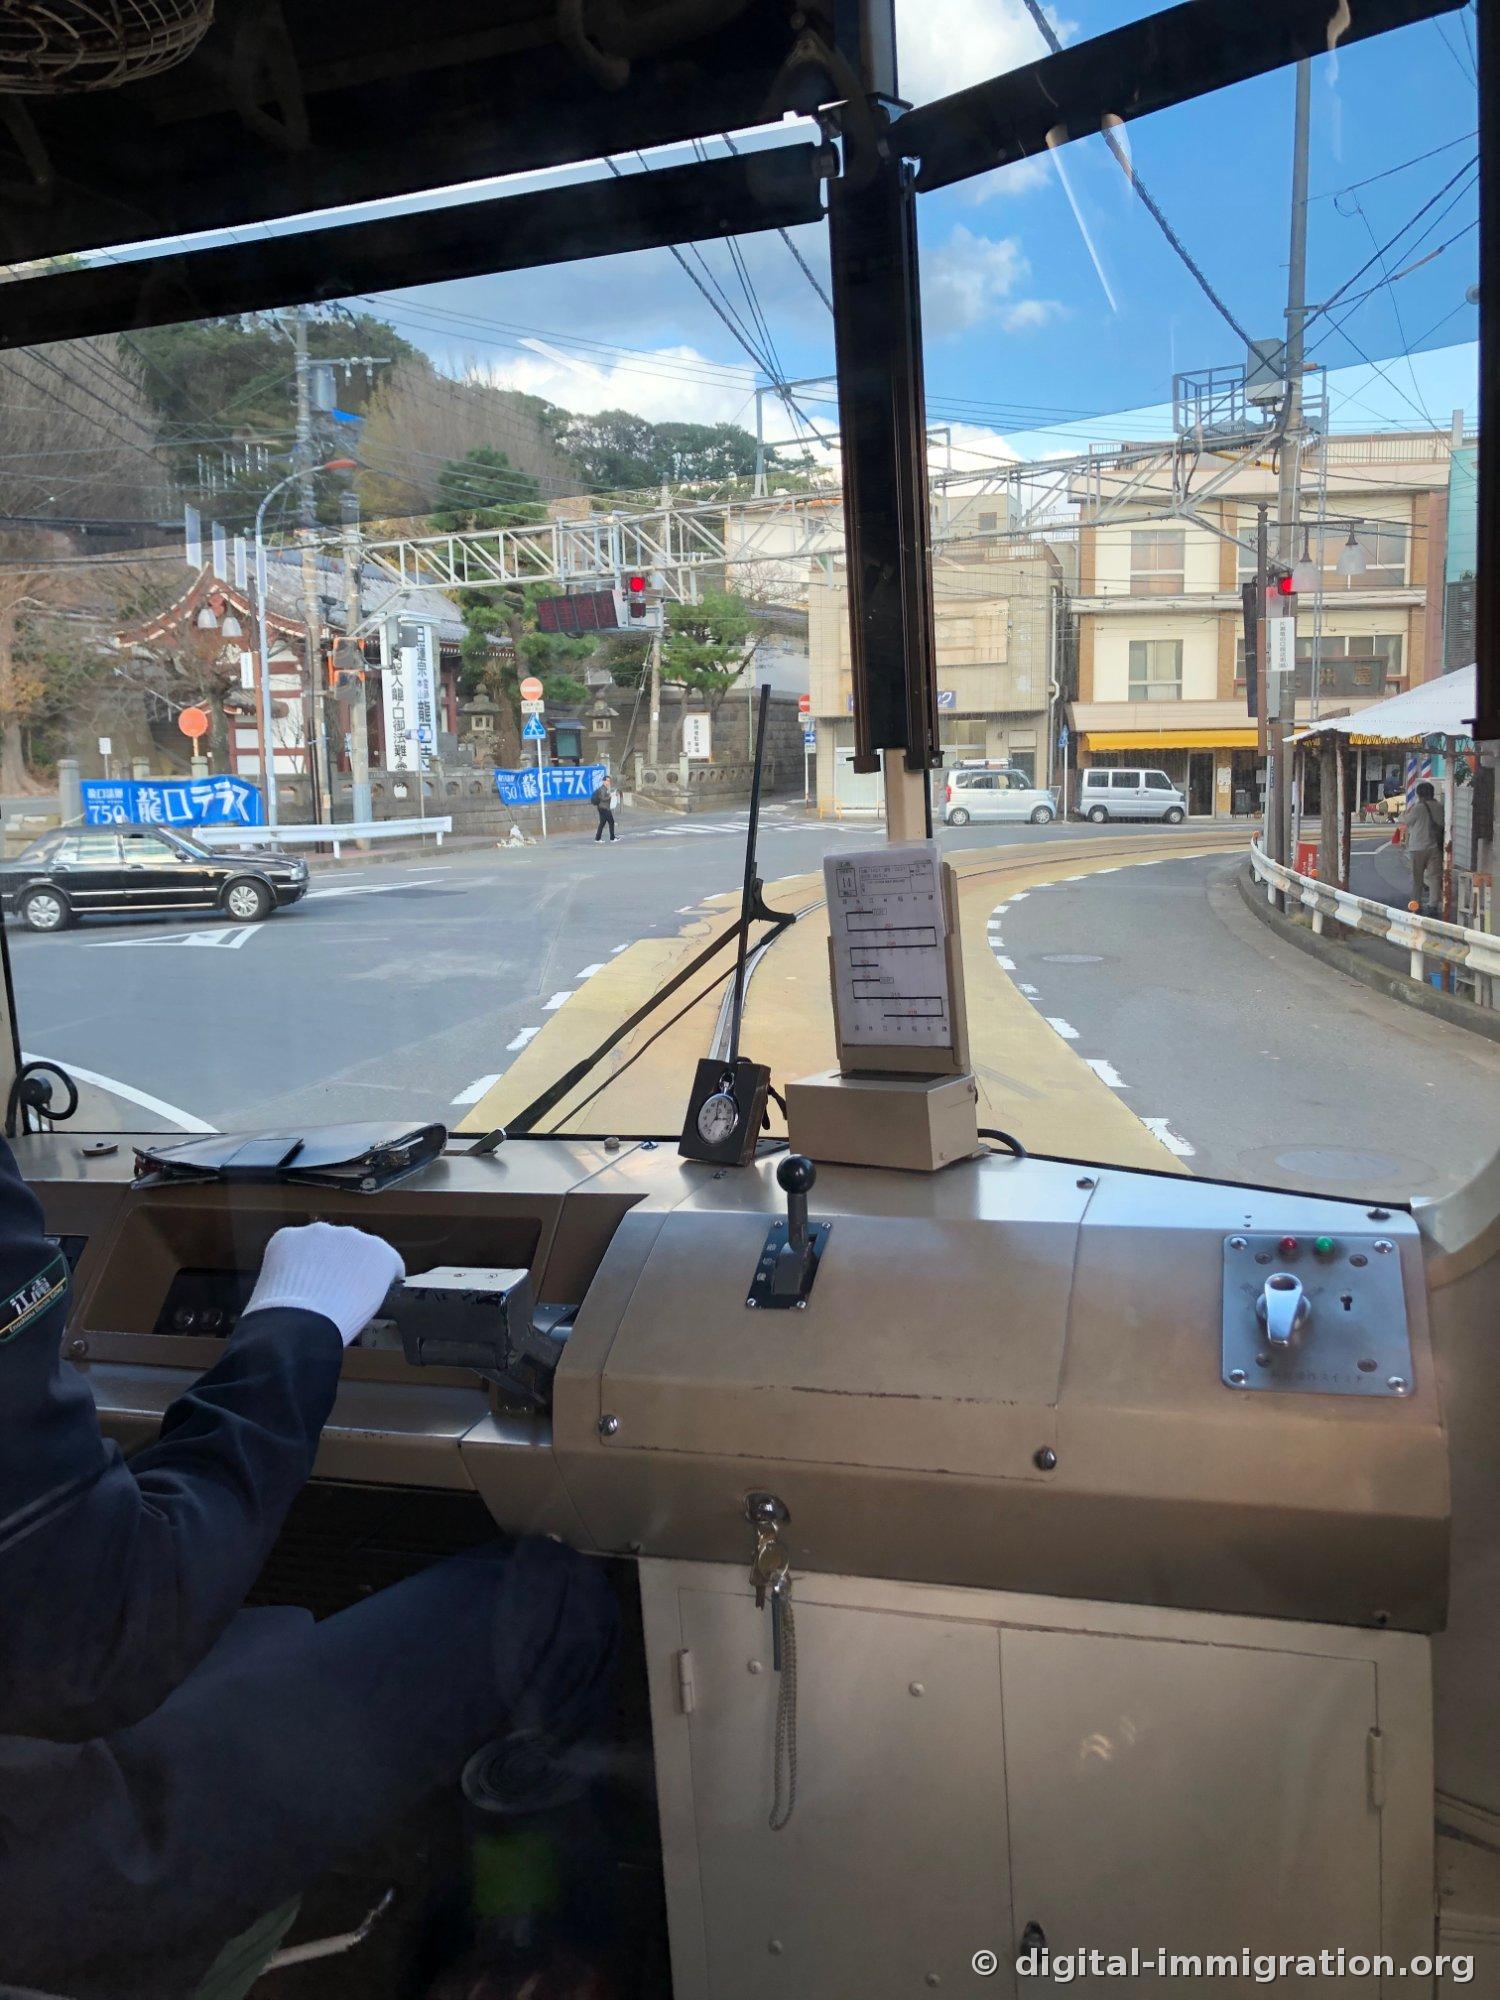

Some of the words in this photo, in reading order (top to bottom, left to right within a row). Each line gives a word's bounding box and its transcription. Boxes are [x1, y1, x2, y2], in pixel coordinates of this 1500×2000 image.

[522, 769, 587, 799] 龍口テラス
[89, 805, 125, 824] 750
[137, 781, 250, 824] 龍口テラス
